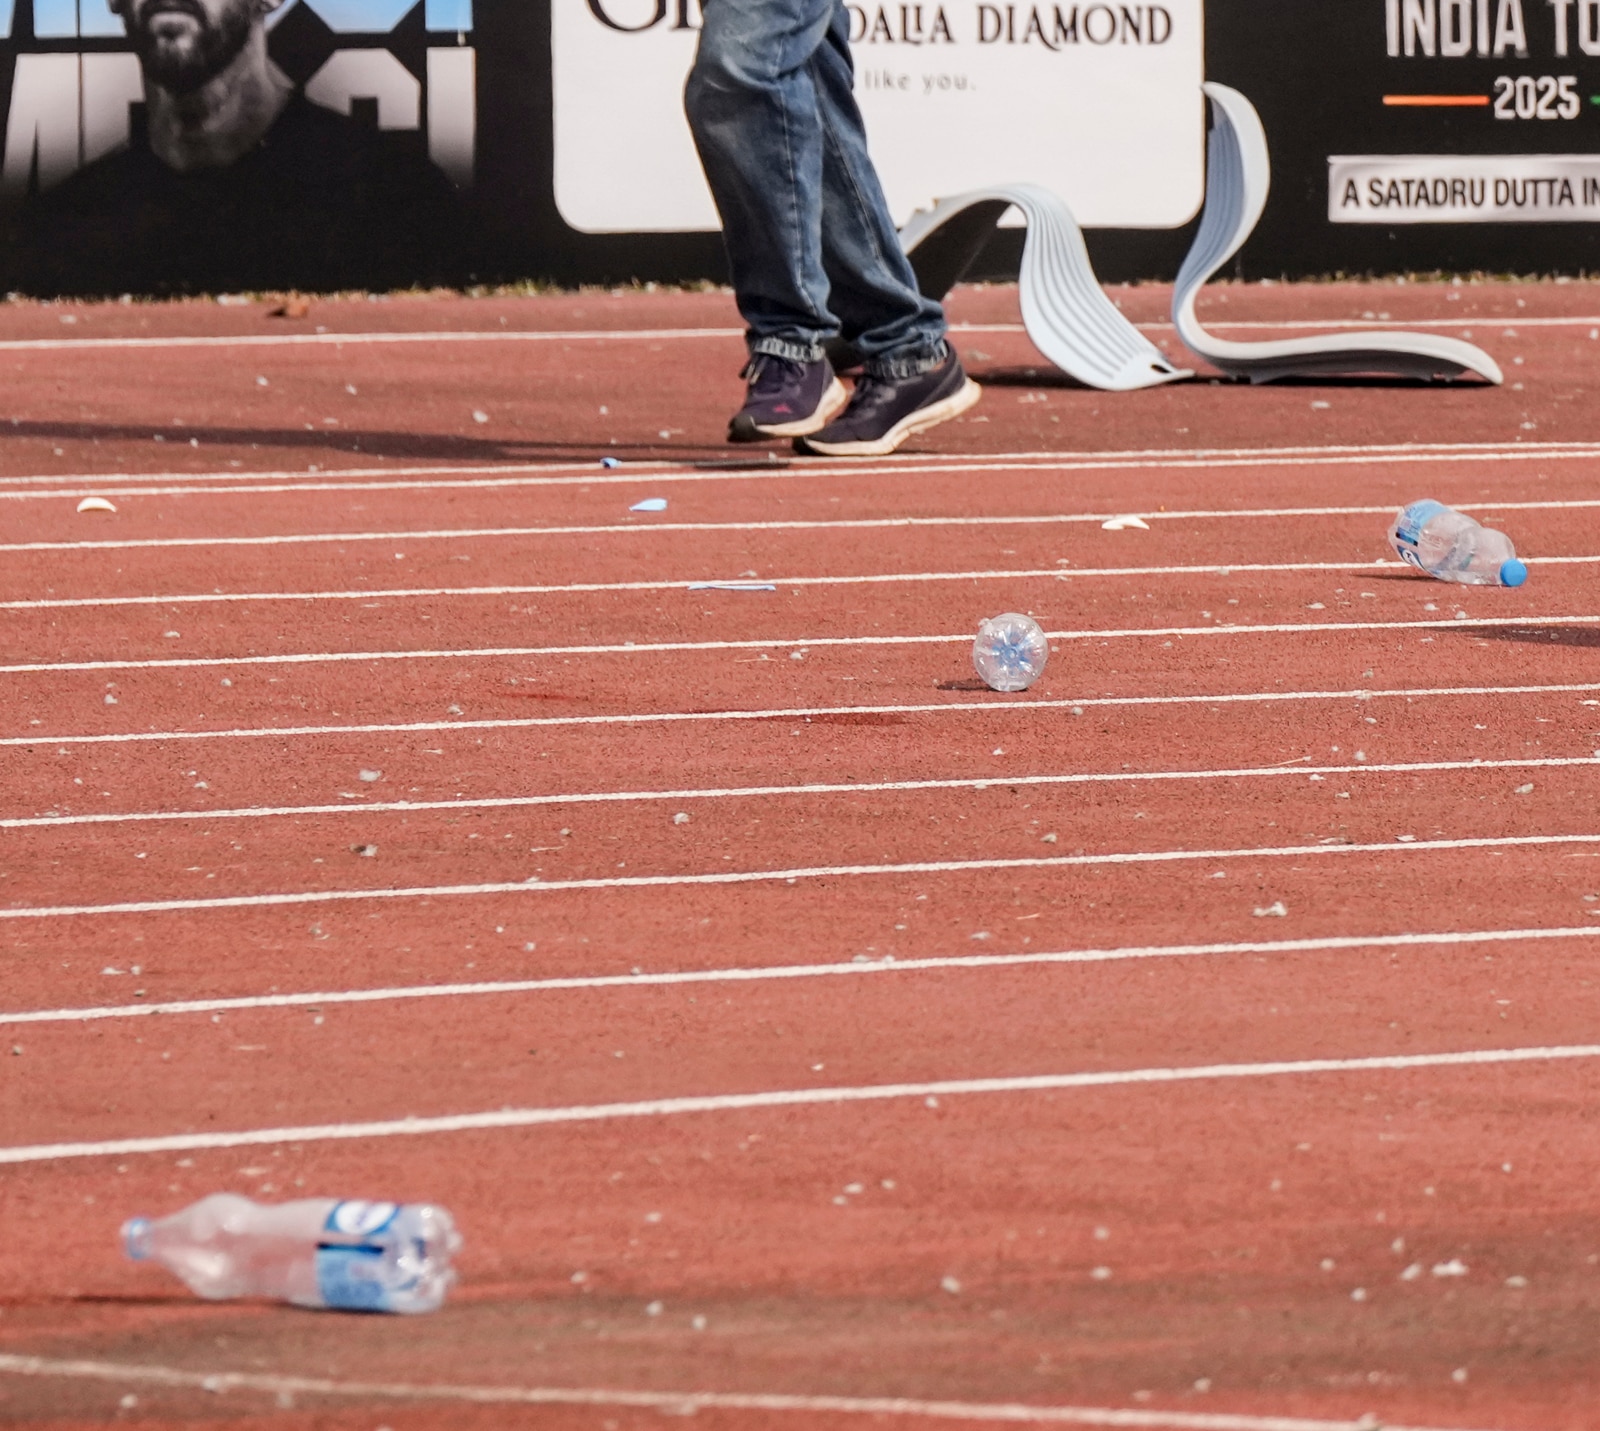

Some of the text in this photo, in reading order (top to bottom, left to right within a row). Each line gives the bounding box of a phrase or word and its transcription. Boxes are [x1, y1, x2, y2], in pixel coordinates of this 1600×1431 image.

[977, 4, 1174, 51] DIAMOND
[864, 70, 977, 99] like you.
[1494, 76, 1581, 121] 2025
[1341, 177, 1360, 209] A
[1367, 177, 1486, 208] SATADRU
[1494, 176, 1576, 208] DUTTA
